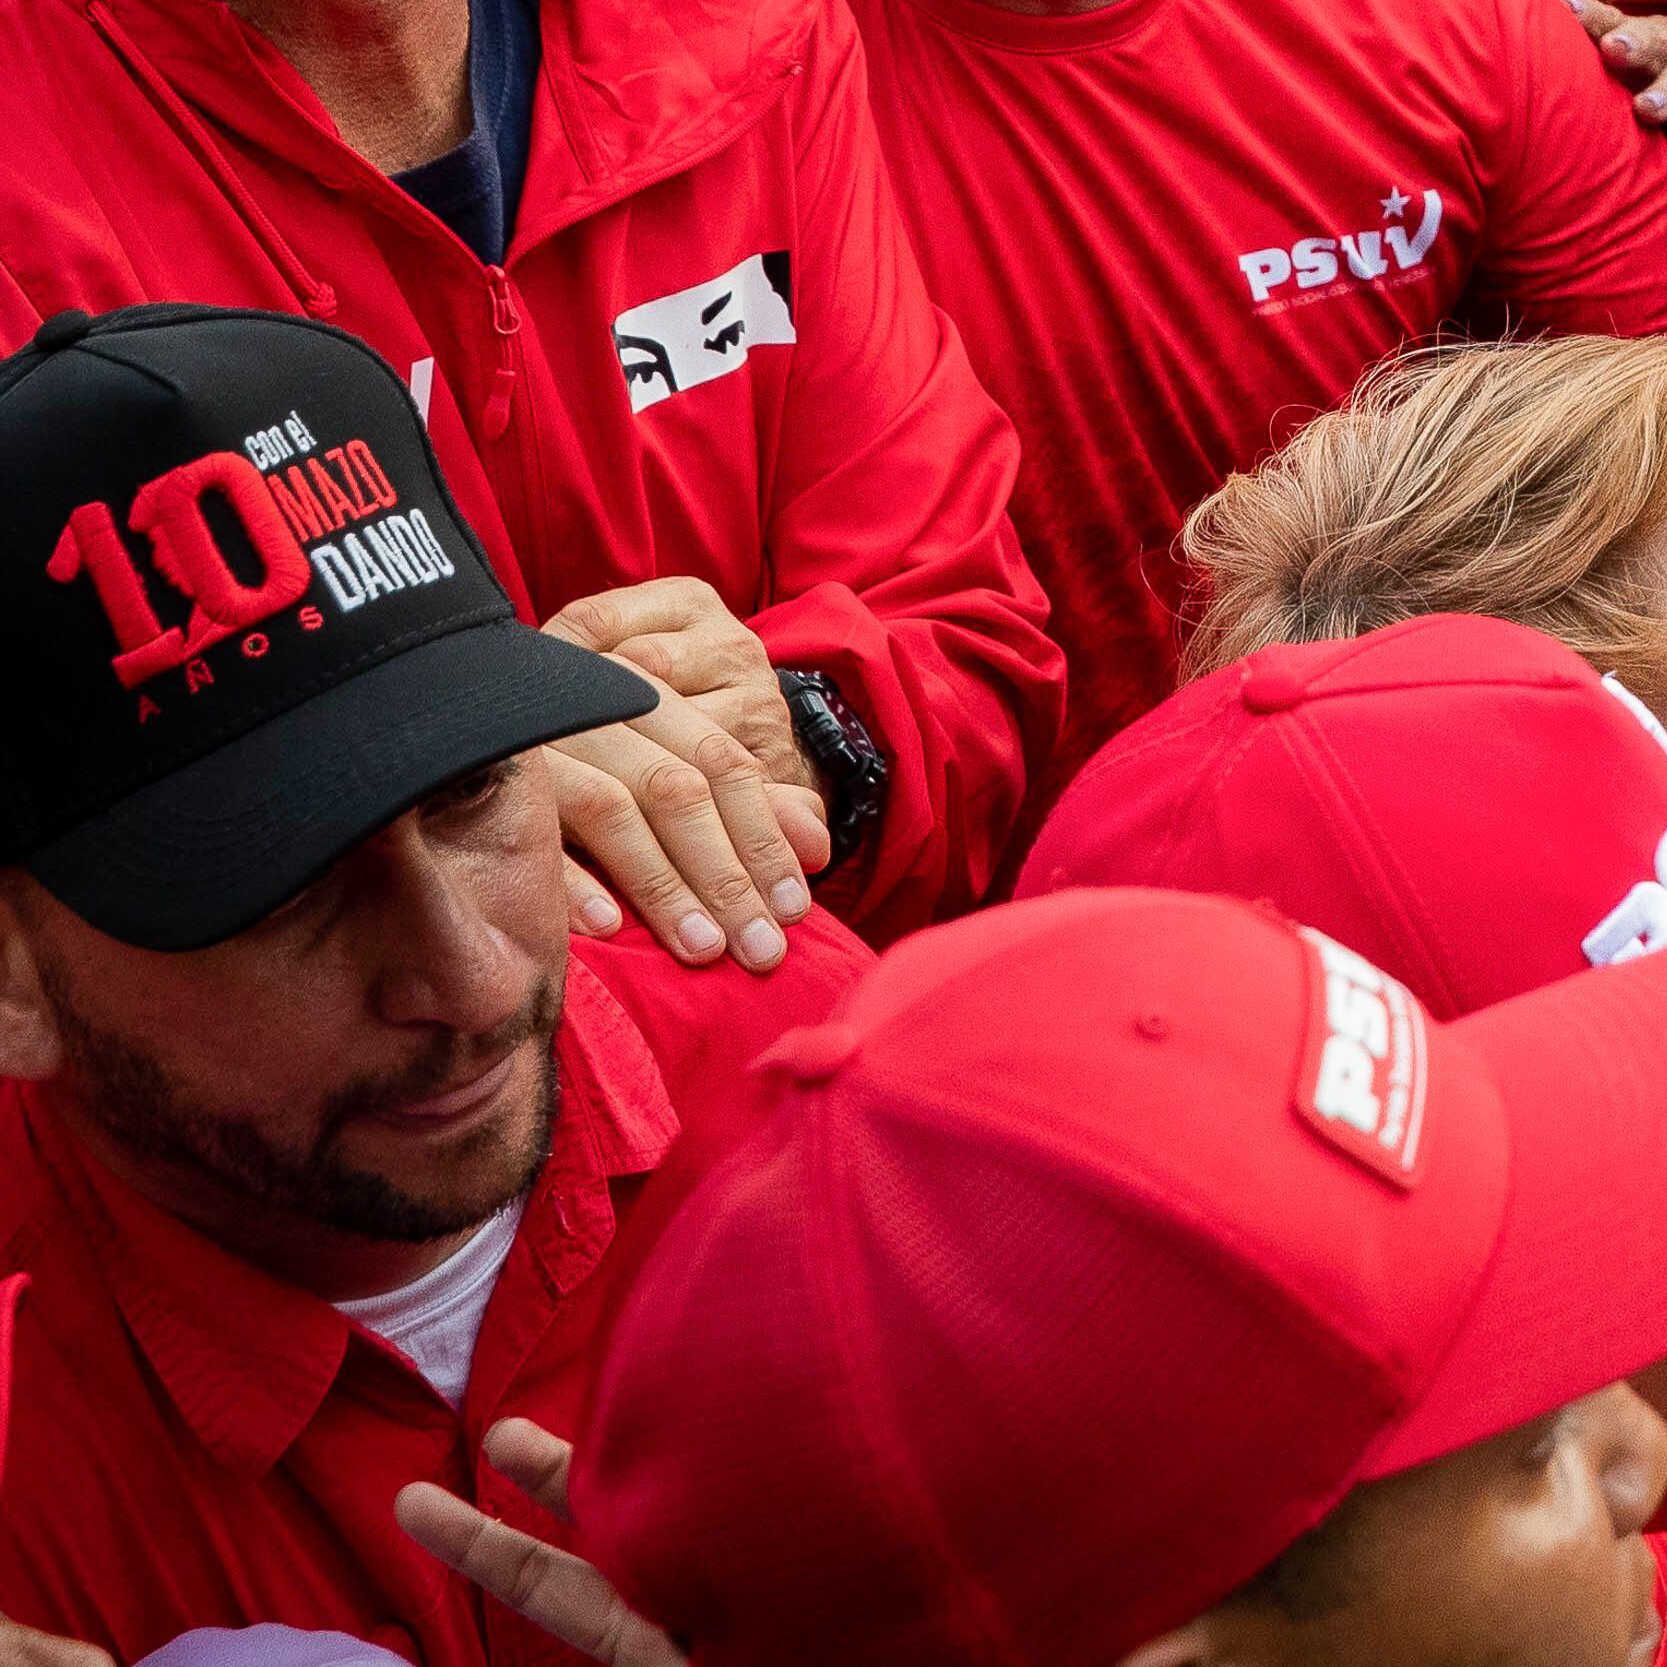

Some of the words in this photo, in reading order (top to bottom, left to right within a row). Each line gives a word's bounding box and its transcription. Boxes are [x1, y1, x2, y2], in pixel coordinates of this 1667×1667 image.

[245, 424, 294, 472] con
[283, 409, 318, 453] el
[266, 439, 398, 543] MAZO
[46, 450, 313, 691] 10
[310, 508, 456, 613] DANDO
